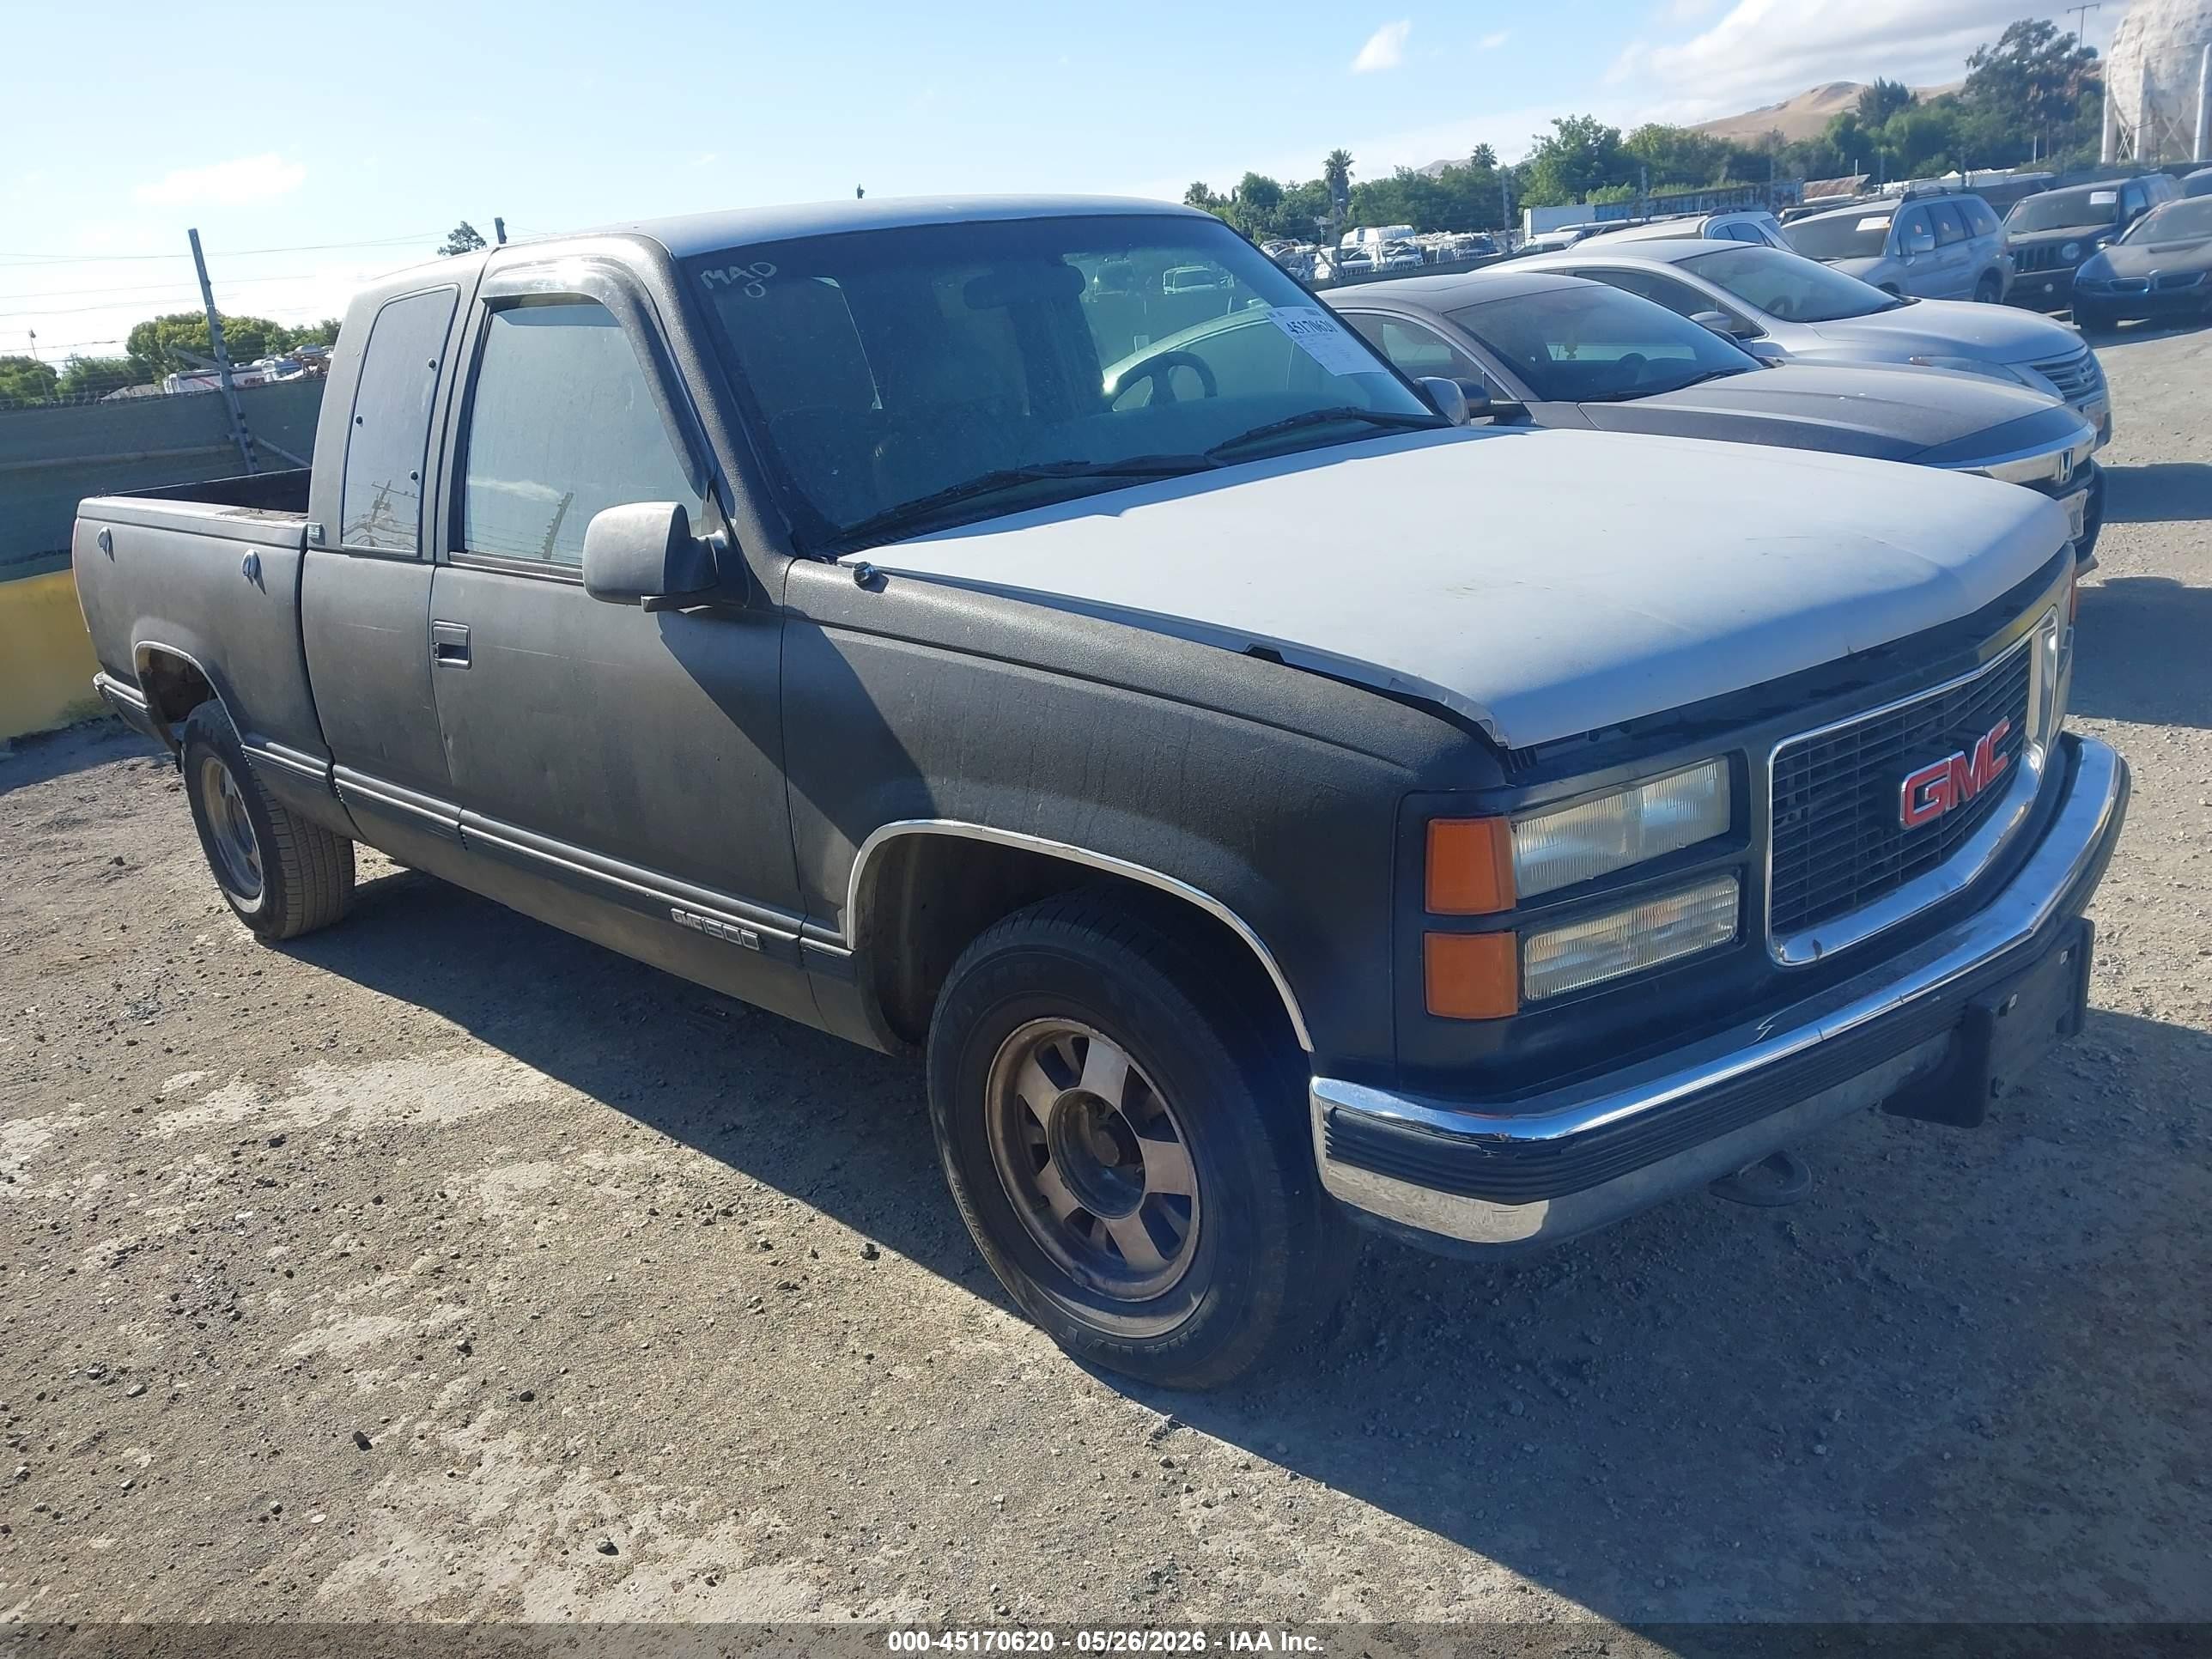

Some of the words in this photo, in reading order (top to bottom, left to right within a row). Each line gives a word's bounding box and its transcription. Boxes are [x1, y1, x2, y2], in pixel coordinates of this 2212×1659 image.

[1899, 714, 2011, 830] GMC
[670, 908, 703, 931] GMC
[701, 916, 760, 951] 1500
